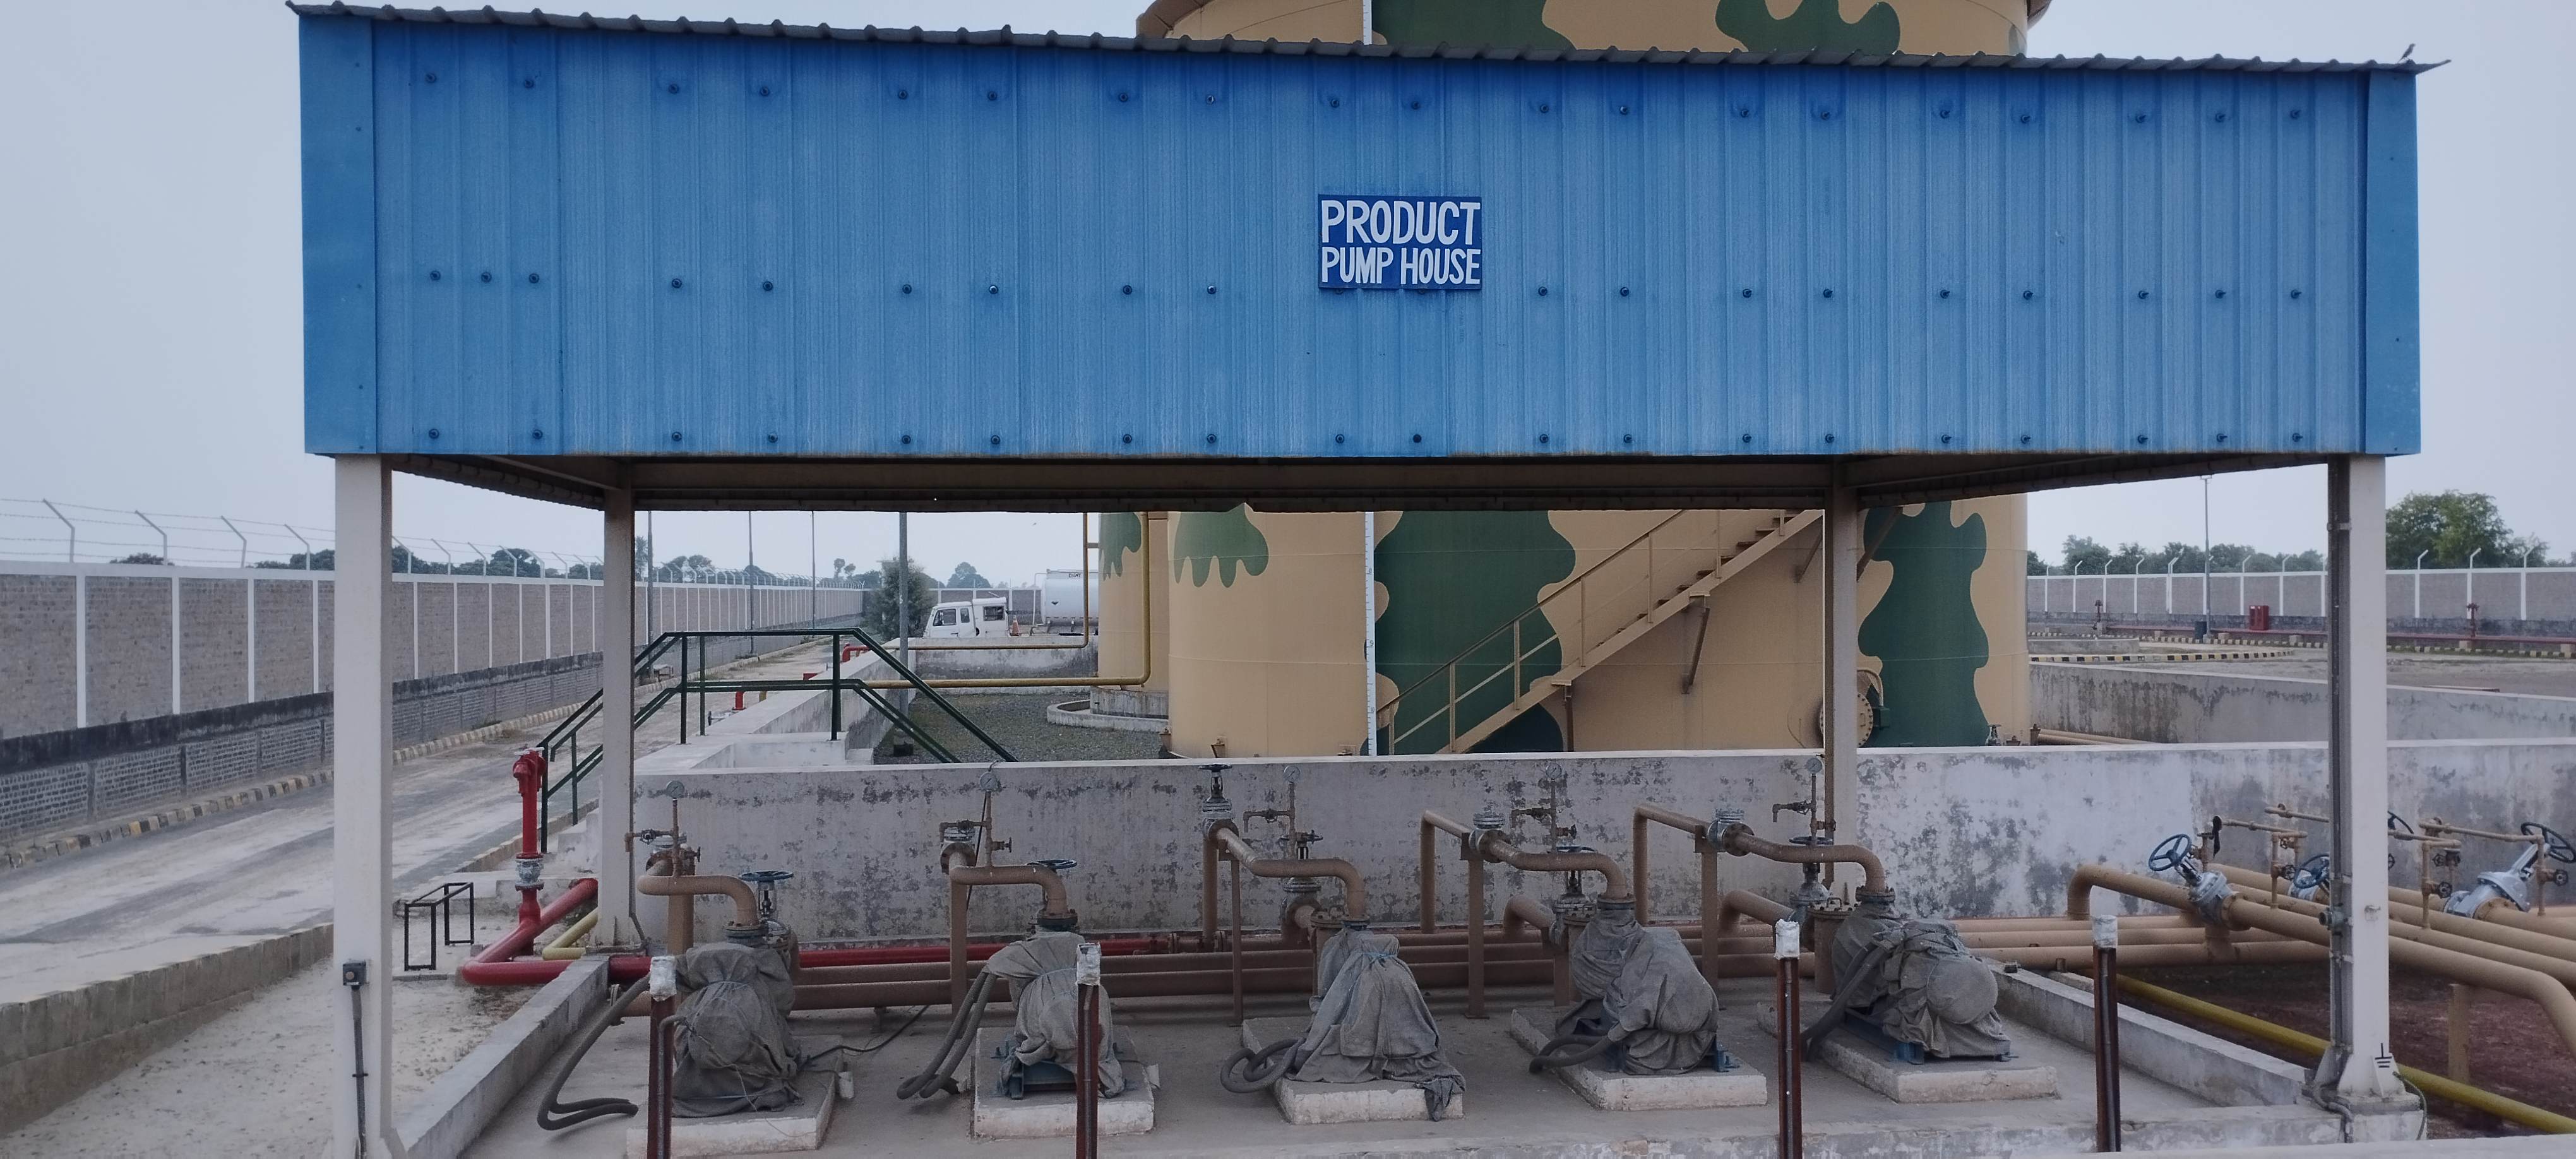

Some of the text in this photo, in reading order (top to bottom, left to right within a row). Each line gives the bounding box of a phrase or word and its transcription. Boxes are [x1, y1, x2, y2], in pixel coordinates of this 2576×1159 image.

[1321, 199, 1481, 245] PRODUCT
[1321, 246, 1481, 285] PUMP HOUSE
